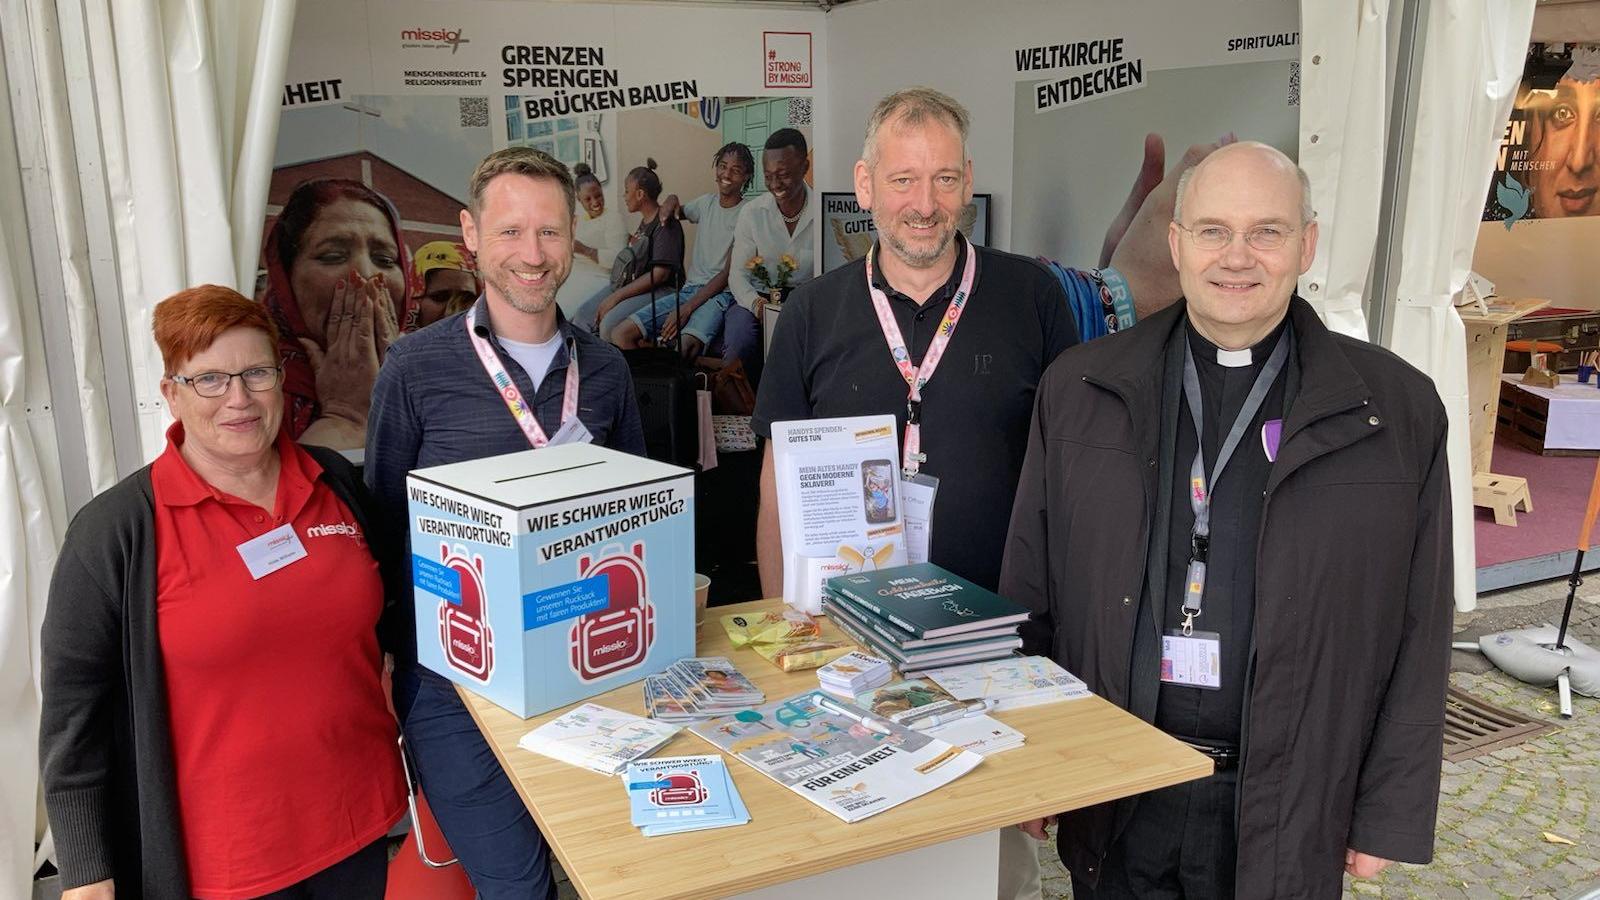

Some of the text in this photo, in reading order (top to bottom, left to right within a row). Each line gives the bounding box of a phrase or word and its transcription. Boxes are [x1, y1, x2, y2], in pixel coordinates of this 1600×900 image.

[501, 45, 604, 66] GRENZEN
[1015, 38, 1124, 72] WELTKIRCHE
[768, 61, 801, 72] STRONG
[503, 68, 619, 88] SPRENGEN
[768, 73, 778, 83] BY
[1037, 59, 1143, 109] ENTDECKEN
[525, 80, 698, 119] BRÜCKEN BAUEN
[1512, 150, 1529, 160] MIT
[1510, 161, 1556, 171] MENSCHEN
[800, 471, 854, 481] GEGEN MODERNE
[800, 480, 835, 489] SKLAVEREI
[410, 486, 502, 529] WIE SCHWER WIEGT
[527, 488, 675, 533] WIE SCHWER WIEGT
[307, 522, 356, 538] missio
[419, 518, 511, 547] VERANTWORTUNG?
[541, 499, 685, 561] VERANTWORTUNG?
[535, 585, 583, 603] Gewinnen Sie
[536, 591, 596, 613] unseren Rucksack
[536, 596, 607, 621] mit fairen Produkten!
[593, 639, 627, 656] missio
[803, 770, 838, 791] FÜR
[835, 759, 867, 780] EINE
[861, 745, 897, 766] WELT
